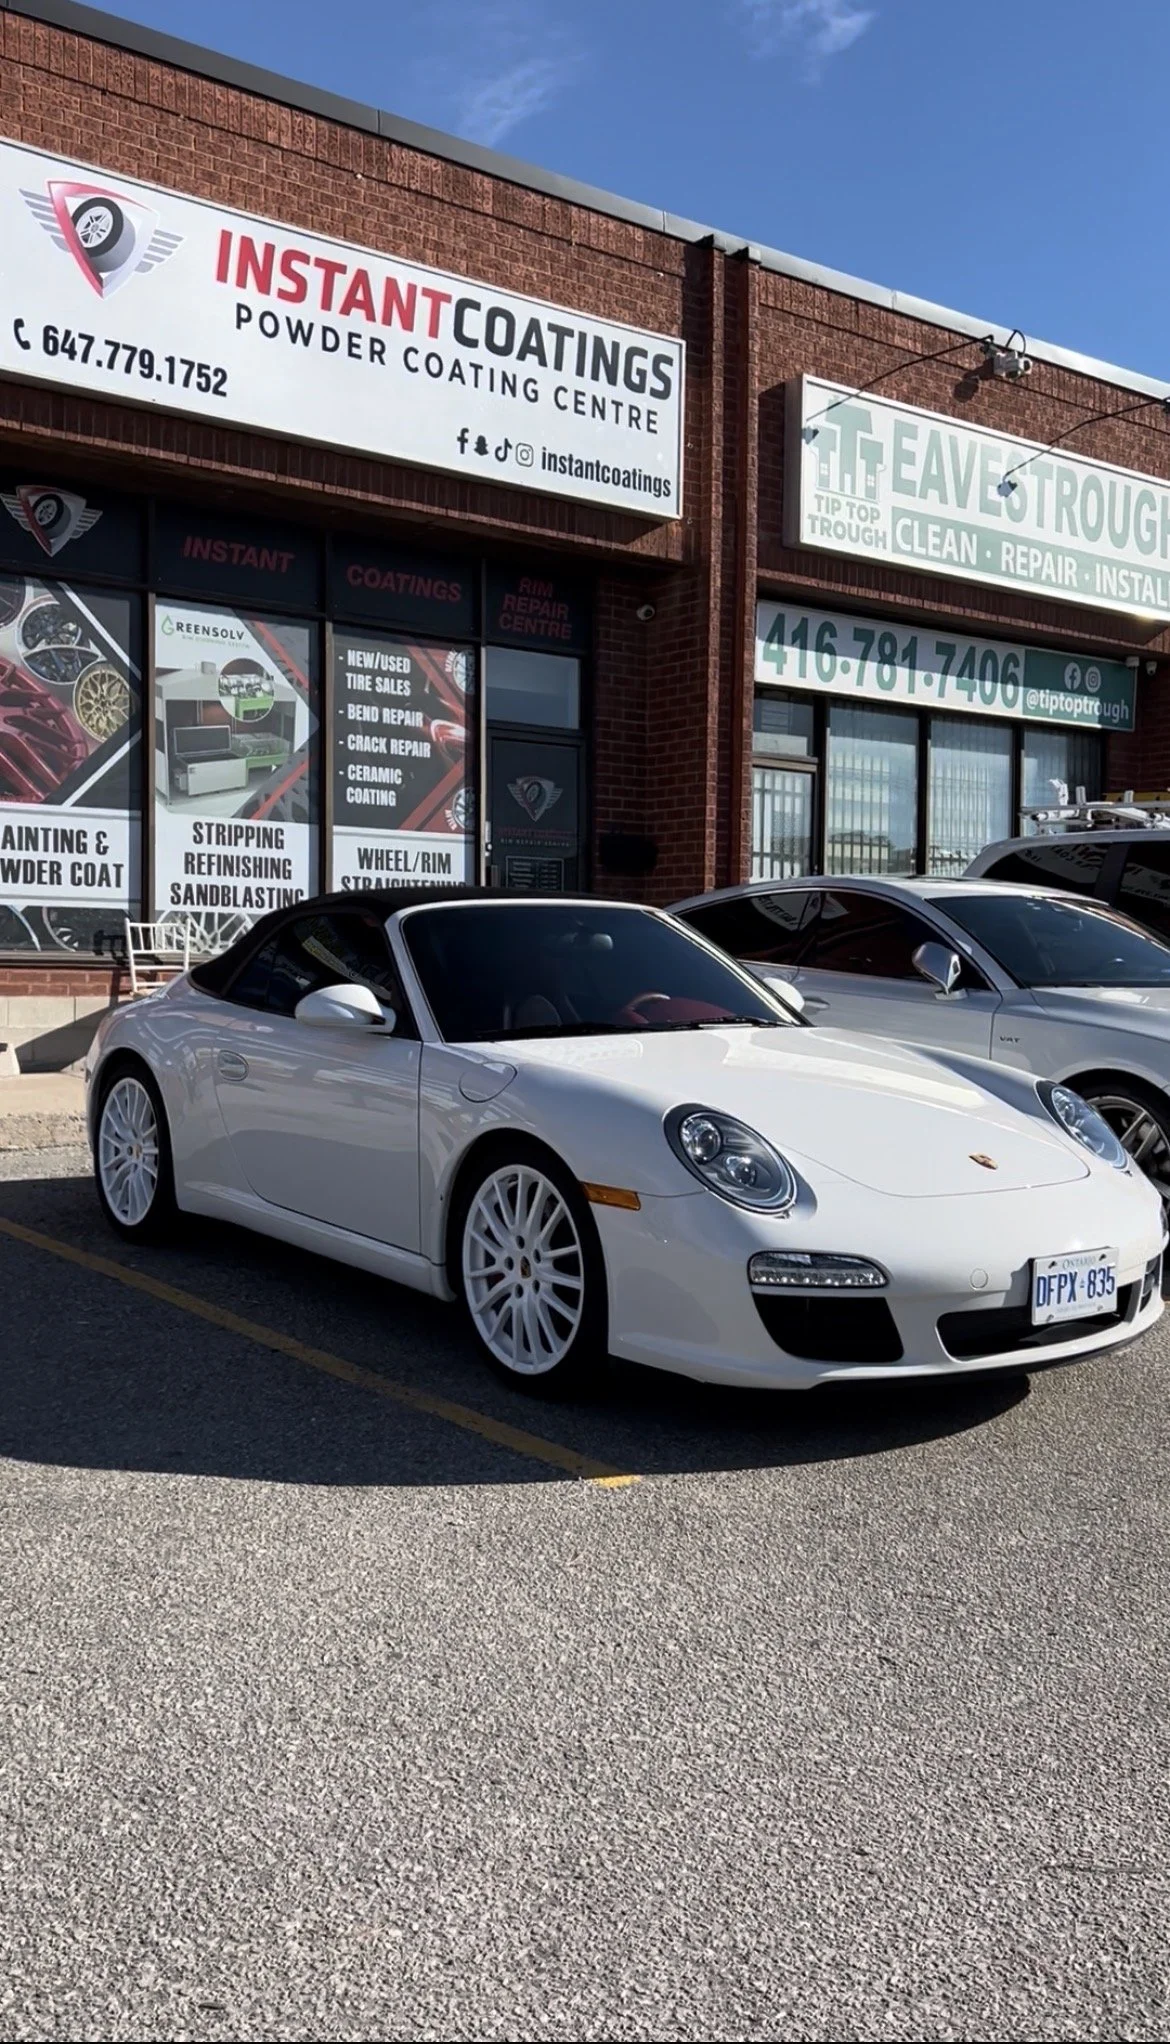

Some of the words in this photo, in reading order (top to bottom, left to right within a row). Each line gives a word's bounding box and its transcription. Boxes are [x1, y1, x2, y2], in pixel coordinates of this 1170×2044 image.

[42, 324, 228, 398] 647.779.1752
[235, 304, 386, 366] POWDER
[403, 347, 539, 403] COATING
[554, 386, 659, 435] CENTRE
[542, 447, 672, 498] instantcoatings
[814, 494, 842, 516] TIP
[846, 501, 881, 524] TOP
[807, 513, 887, 550] TROUGH
[183, 536, 295, 573] INSTANT
[896, 517, 978, 566] CLEAN
[1001, 541, 1078, 588] REPAIR
[1095, 562, 1170, 607] INSTAL
[347, 565, 462, 601] COATINGS
[519, 576, 553, 597] RIM
[502, 593, 569, 621] REPAIR
[499, 612, 573, 640] CENTRE
[347, 650, 411, 674] NEW/USED
[345, 673, 372, 692] TIRE
[375, 676, 411, 697] SALES
[347, 703, 379, 723] BEND
[382, 708, 424, 728] REPAIR
[1026, 688, 1129, 723] @tiptoptrough
[347, 734, 387, 755] CRACK
[390, 738, 431, 758] REPAIR
[347, 764, 402, 785] CERAMIC
[346, 787, 397, 807] COATING
[1, 825, 88, 855] AINTING
[95, 831, 109, 855] &
[192, 821, 285, 850] STRIPPING
[70, 861, 124, 888] COAT
[184, 852, 292, 880] REFINISHING
[357, 847, 452, 874] WHEEL/RIM
